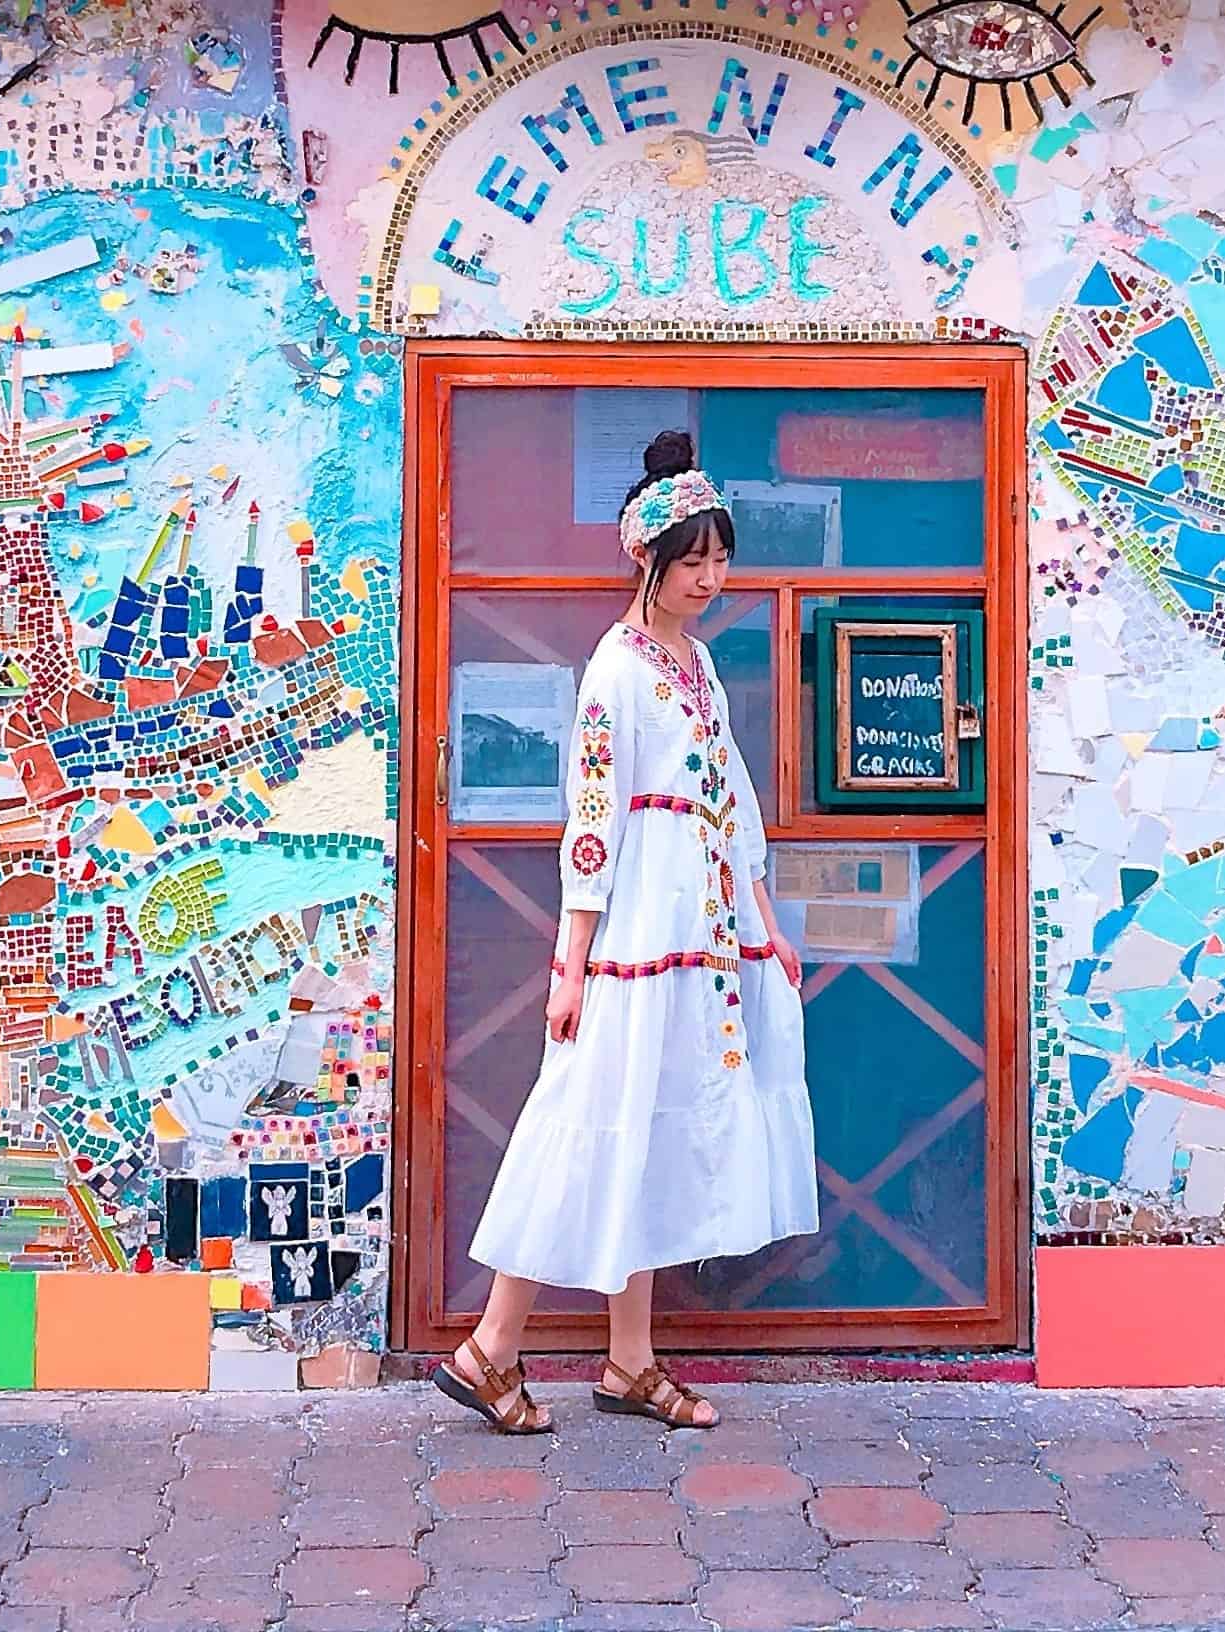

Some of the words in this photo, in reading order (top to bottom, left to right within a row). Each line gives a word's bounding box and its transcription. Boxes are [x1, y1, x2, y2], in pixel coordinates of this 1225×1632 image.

[560, 195, 838, 316] SUBE
[857, 753, 935, 776] GRACIAS
[138, 858, 228, 956] OF
